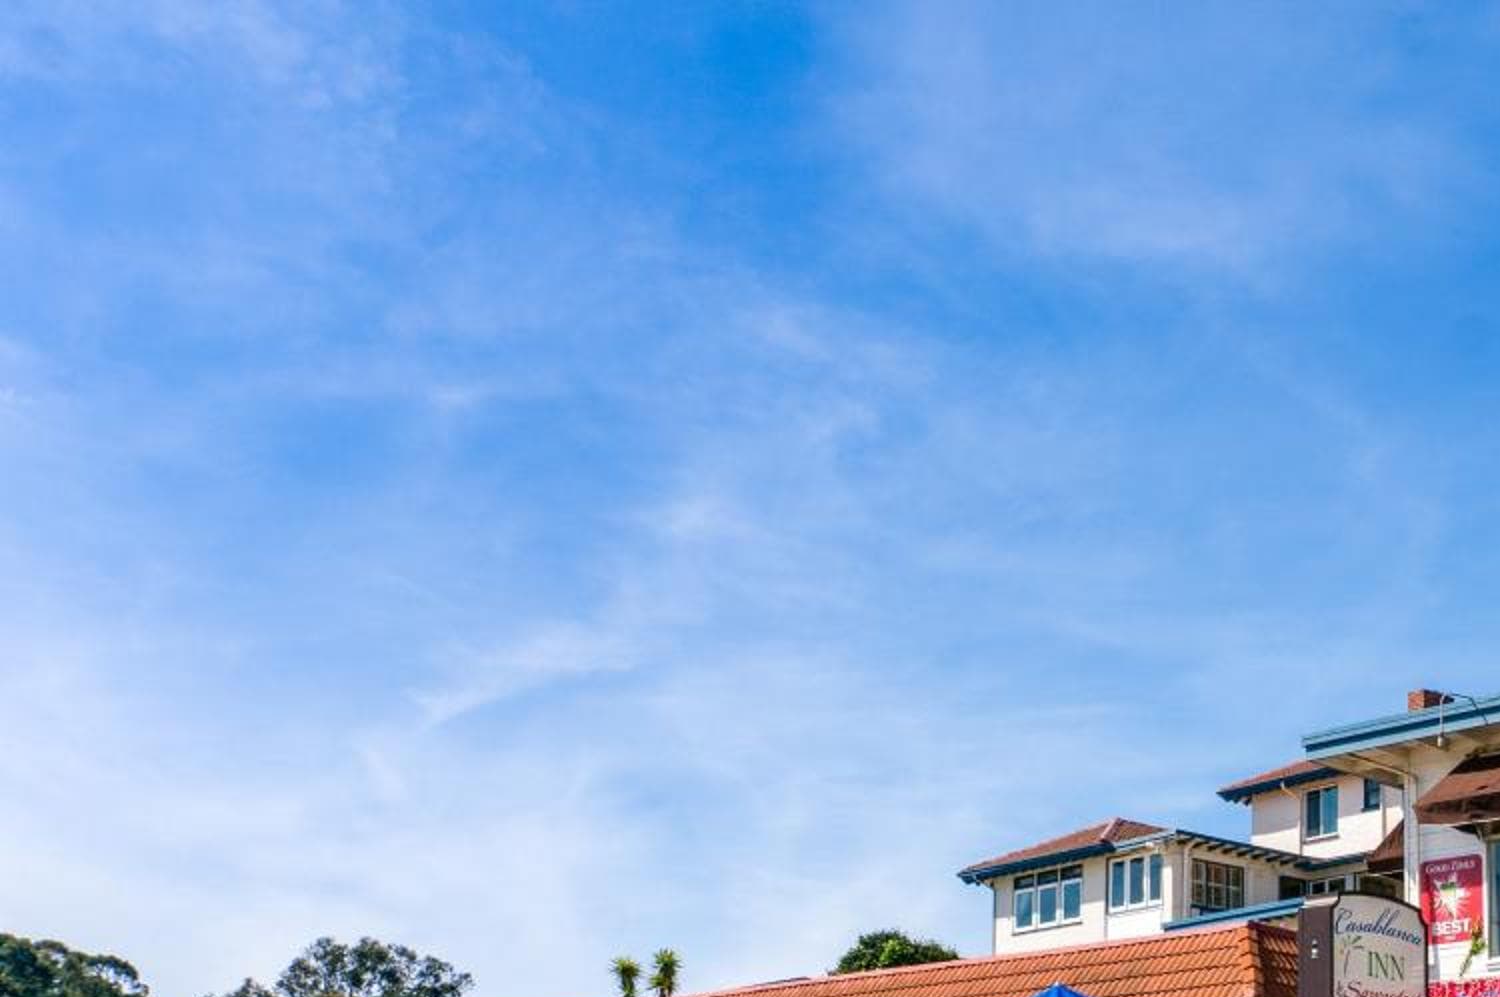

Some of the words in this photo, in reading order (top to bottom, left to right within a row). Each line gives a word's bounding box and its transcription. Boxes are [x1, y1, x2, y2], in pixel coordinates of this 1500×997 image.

[1335, 907, 1421, 945] Casablanca
[1432, 919, 1470, 937] BEST
[1367, 951, 1405, 980] INN
